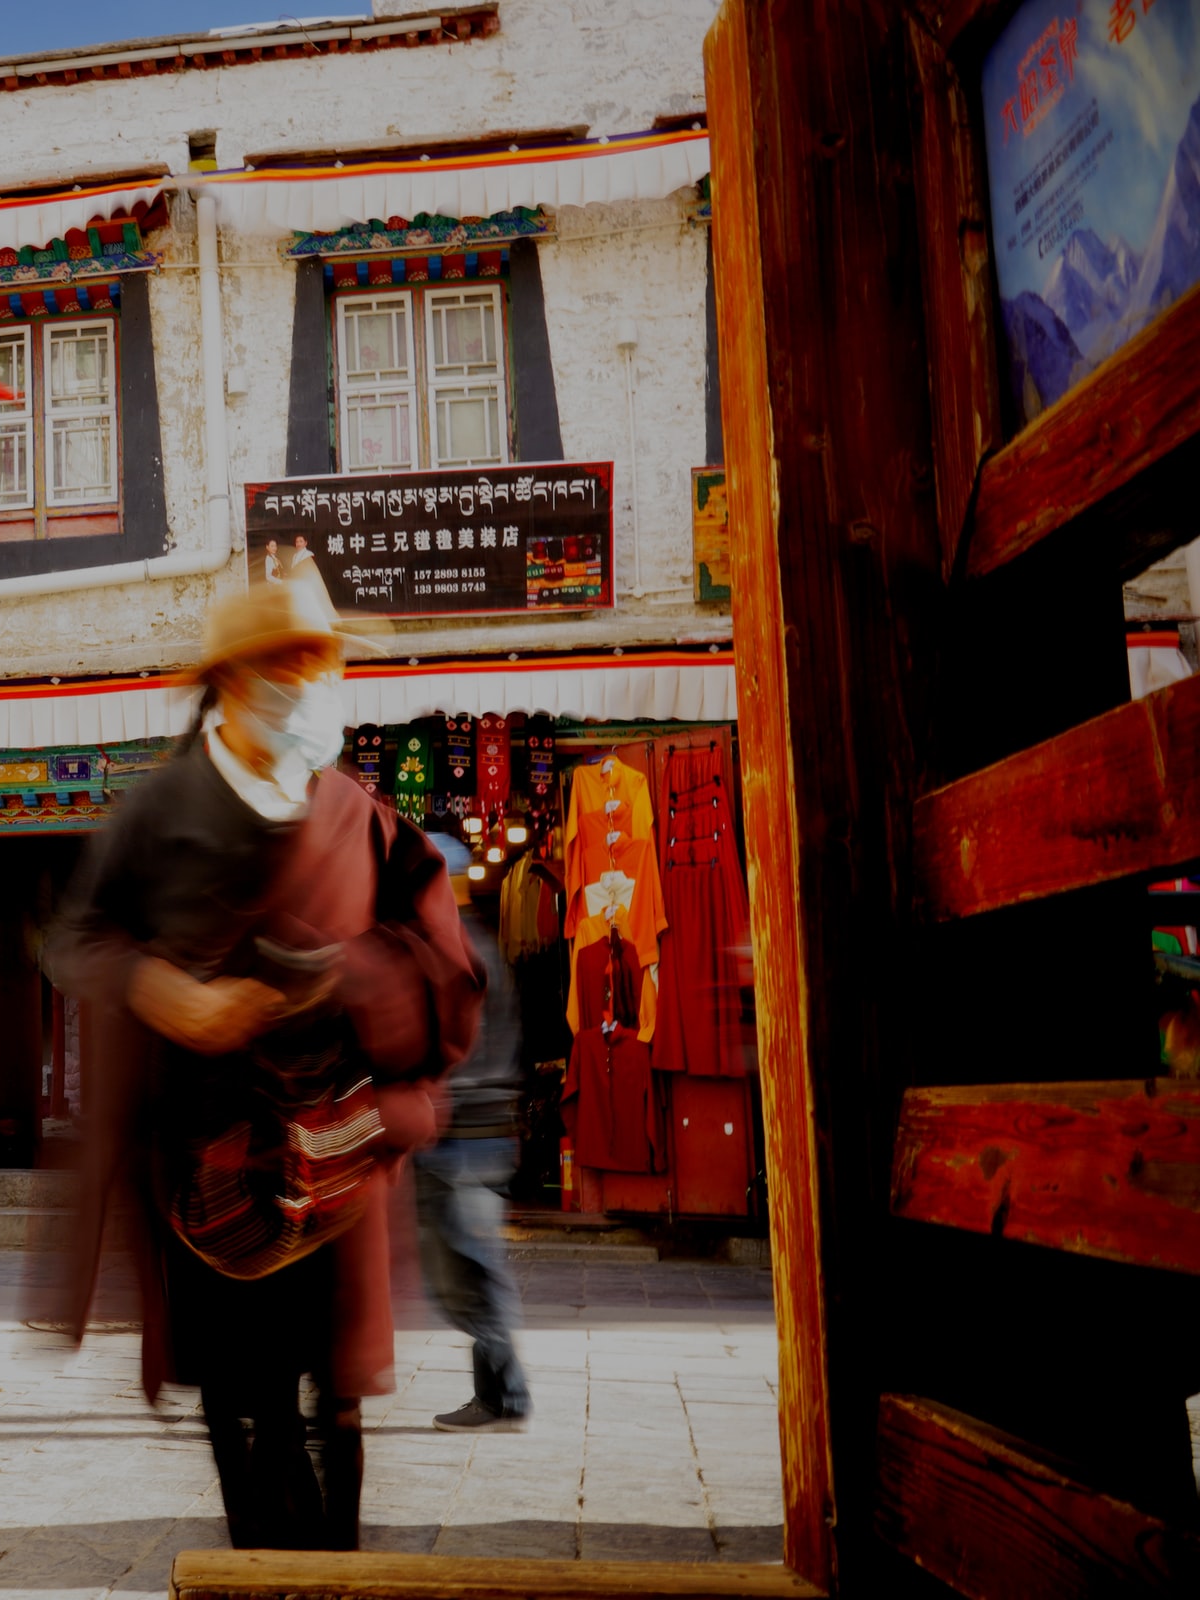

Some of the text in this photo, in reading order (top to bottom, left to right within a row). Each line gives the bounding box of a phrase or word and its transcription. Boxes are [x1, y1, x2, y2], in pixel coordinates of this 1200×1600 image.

[414, 567, 486, 581] 157 2893 8155
[414, 581, 486, 595] 133 9803 5743
